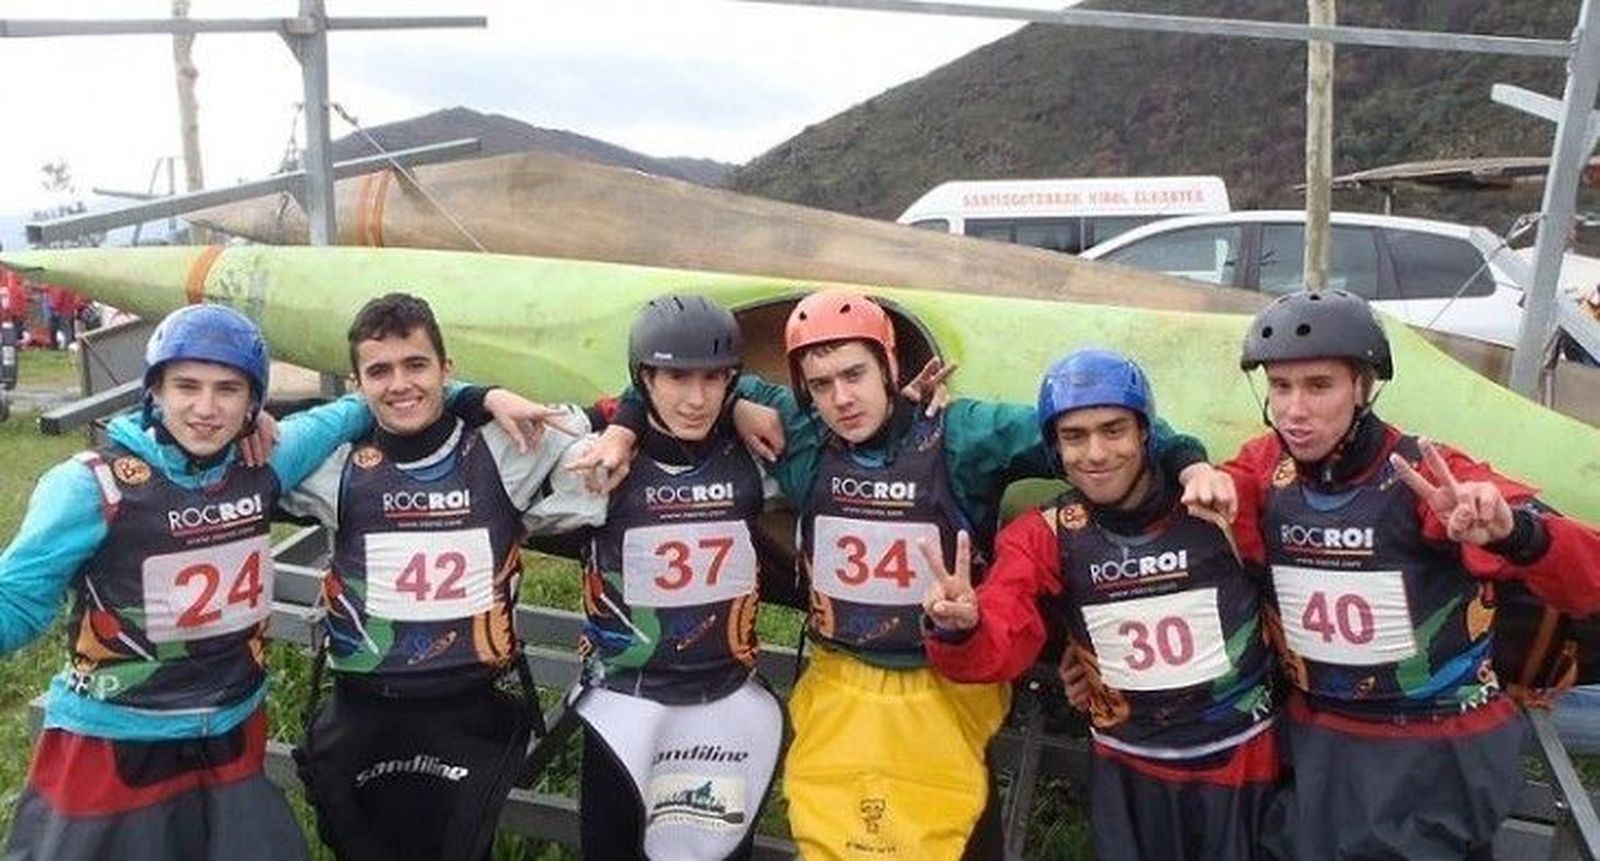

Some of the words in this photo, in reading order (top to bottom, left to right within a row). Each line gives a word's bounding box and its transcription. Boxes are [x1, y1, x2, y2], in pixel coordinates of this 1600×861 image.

[383, 489, 471, 511] ROCROI
[645, 482, 733, 503] ROCROI
[832, 476, 916, 499] ROCROI
[168, 494, 263, 530] ROCROI
[1281, 524, 1374, 547] ROCROI
[395, 552, 467, 602] 42
[654, 538, 734, 590] 37
[835, 535, 917, 588] 34
[1090, 550, 1188, 584] ROCROI
[174, 551, 264, 628] 24
[1301, 591, 1375, 645] 40
[1118, 616, 1196, 672] 30
[355, 755, 469, 787] sandiline
